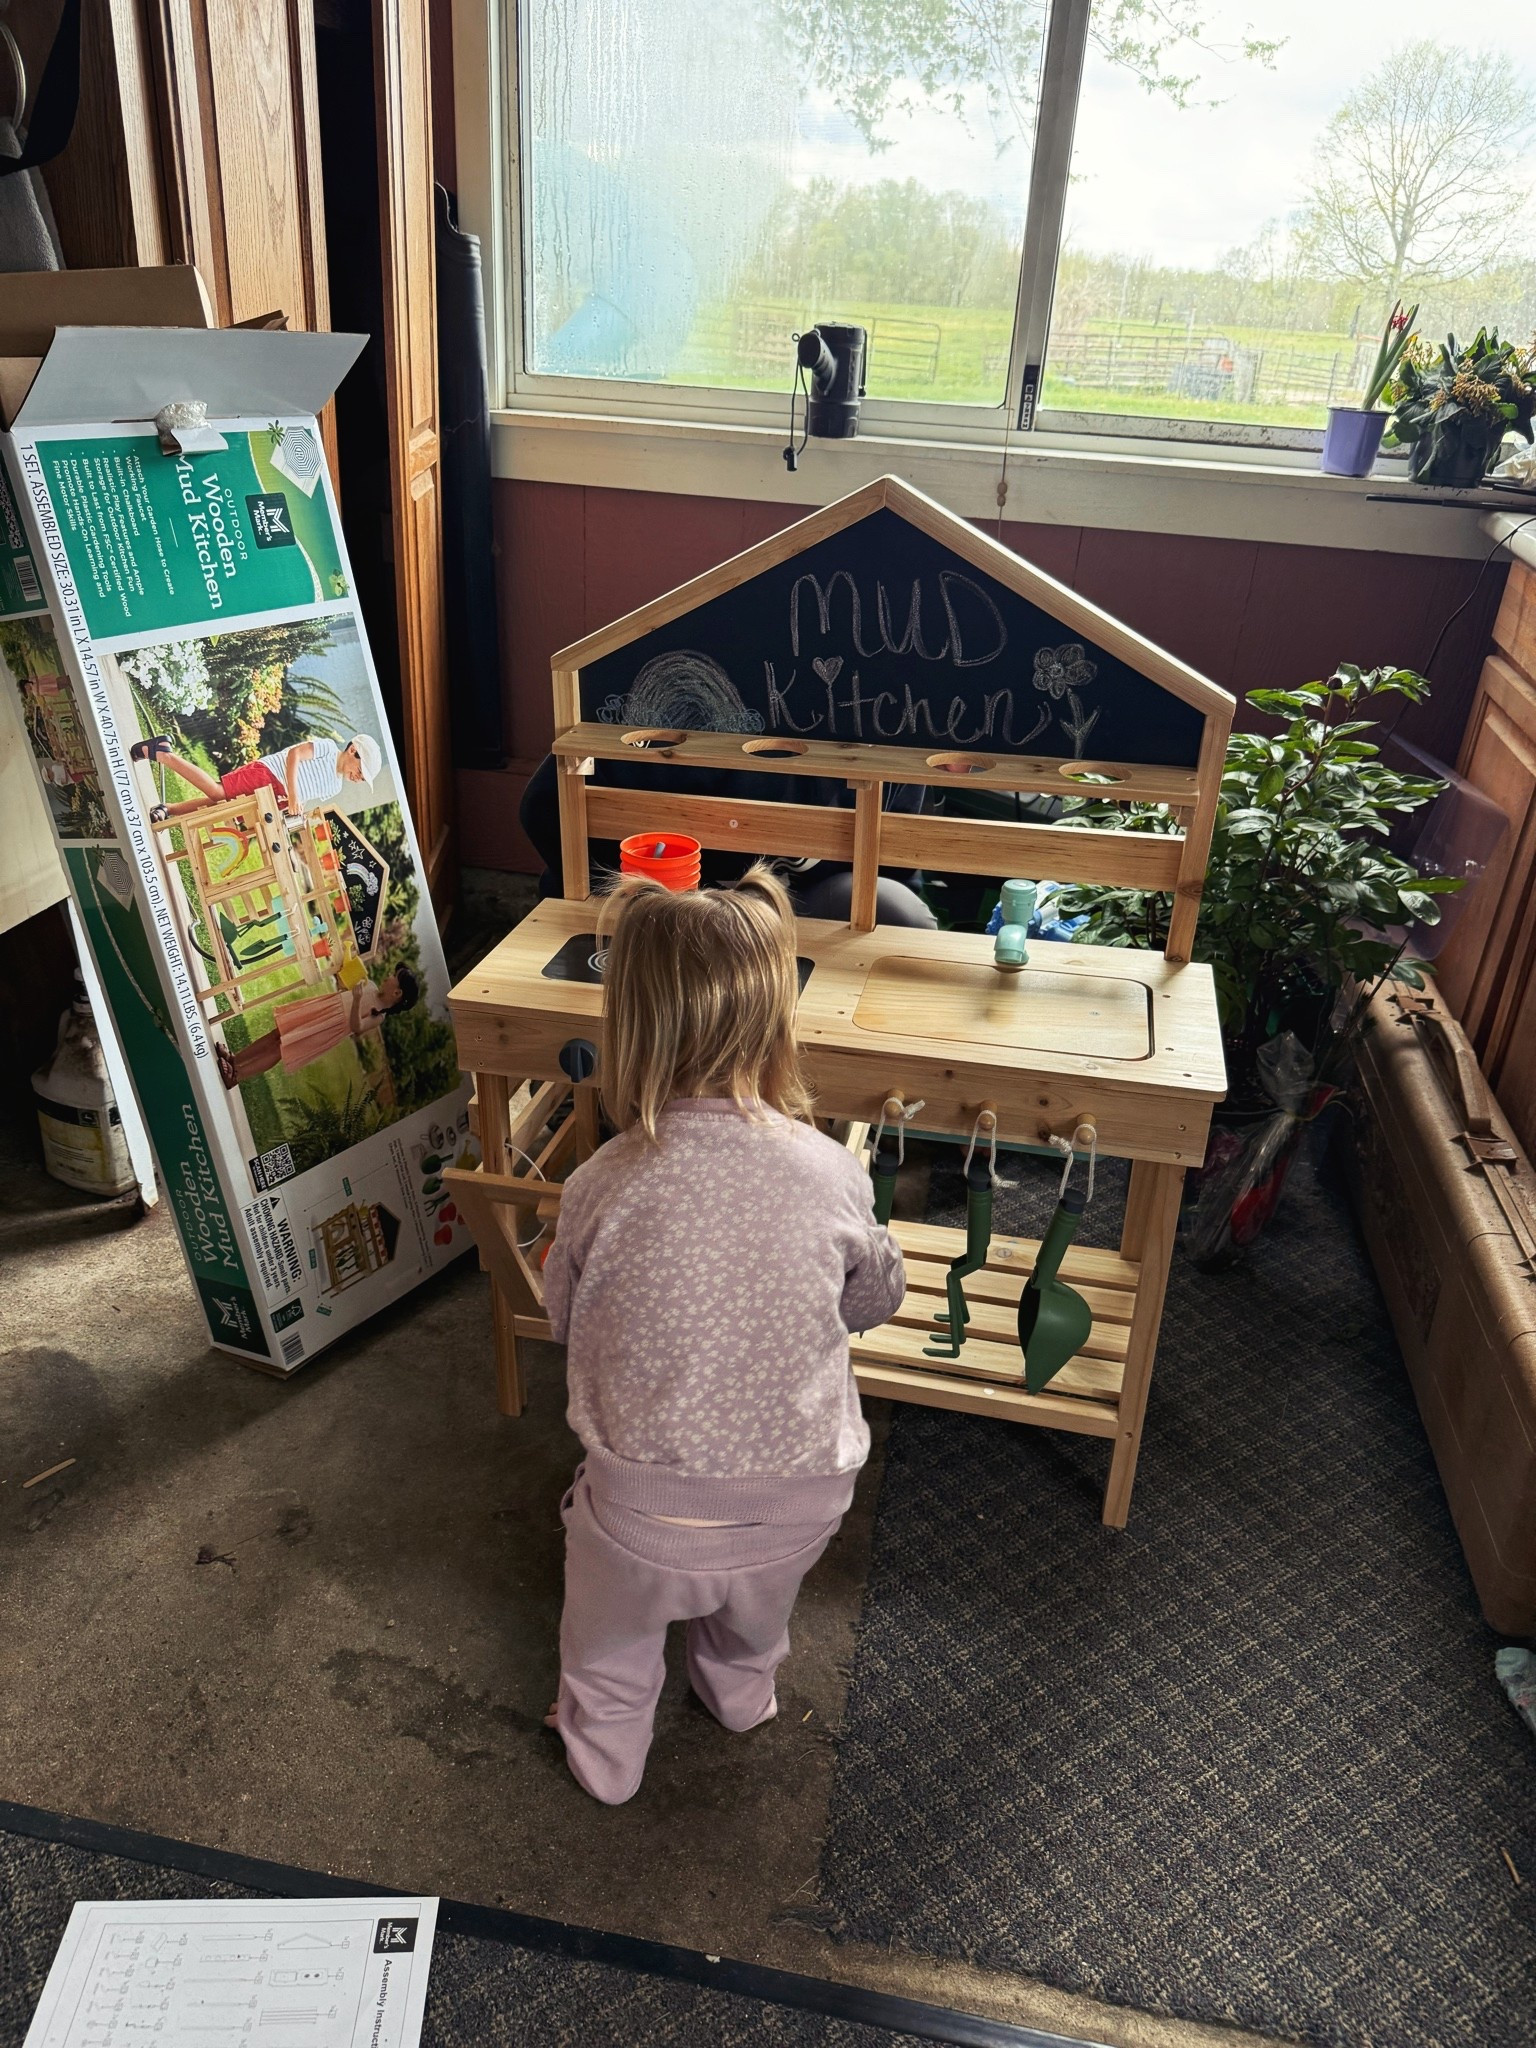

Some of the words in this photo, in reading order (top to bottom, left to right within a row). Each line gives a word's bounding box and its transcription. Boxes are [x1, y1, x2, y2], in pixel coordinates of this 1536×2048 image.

[22, 454, 40, 478] SET.
[102, 457, 116, 492] Realistic
[52, 460, 61, 479] Fine
[58, 481, 70, 506] Motor
[66, 508, 76, 531] Skills
[112, 494, 121, 512] Play
[113, 456, 126, 487] Built-in
[122, 488, 140, 536] Chalkboard
[125, 456, 138, 491] Working
[134, 493, 146, 521] Faucet
[30, 480, 61, 550] ASSEMBLED
[61, 460, 75, 496] Promote
[72, 499, 88, 541] Hands-On
[85, 543, 99, 580] Learning
[96, 582, 106, 597] and
[70, 459, 84, 493] Durable
[80, 495, 92, 523] Plastic
[89, 525, 105, 568] Gardening
[102, 570, 111, 591] Tools
[93, 457, 106, 490] Storage
[107, 506, 120, 541] Outdoor
[117, 543, 130, 574] Kitchen
[126, 576, 134, 591] Fun
[133, 455, 144, 483] Attach
[141, 484, 150, 503] Your
[146, 505, 158, 535] Garden
[154, 536, 164, 557] Hose
[160, 558, 166, 567] to
[163, 568, 174, 595] Create
[202, 472, 236, 578] Wooden
[224, 488, 248, 560] OUTDOOR
[257, 501, 272, 541] Member's
[82, 458, 92, 478] Built
[88, 480, 94, 490] to
[91, 491, 100, 509] Last
[97, 511, 106, 531] from
[109, 555, 124, 591] Certified
[120, 592, 132, 616] Wood
[118, 514, 131, 549] Features
[51, 552, 69, 579] SIZE:
[128, 551, 137, 567] and
[188, 512, 222, 609] Kitchen
[59, 581, 79, 612] 30.31
[132, 568, 144, 595] Ample
[69, 615, 82, 626] in
[75, 636, 89, 644] X
[79, 646, 98, 676] 14.57
[88, 678, 100, 690] in
[93, 690, 107, 703] W
[96, 705, 109, 713] X
[100, 715, 118, 745] 40.75
[108, 746, 120, 757] in
[111, 758, 125, 768] H
[113, 770, 130, 785] (77
[120, 789, 132, 805] cm
[125, 806, 135, 814] x
[127, 814, 141, 826] 37
[132, 830, 144, 846] cm
[136, 846, 146, 854] x
[140, 854, 157, 883] 103.5
[148, 885, 164, 908] cm).
[155, 908, 171, 927] NET
[162, 928, 183, 972] WEIGHT:
[174, 972, 191, 999] 14.11
[182, 999, 197, 1022] LBS.
[188, 1022, 202, 1042] (6.4
[192, 1041, 208, 1061] kg)
[182, 1104, 219, 1204] Kitchen
[175, 1189, 201, 1261] OUTDOOR
[180, 1161, 217, 1262] Wooden
[260, 1198, 274, 1231] CHOKING
[208, 1212, 238, 1269] Mud
[244, 1208, 255, 1226] Adult
[250, 1226, 264, 1259] assembly
[259, 1259, 273, 1290] required.
[252, 1202, 260, 1215] Not
[258, 1224, 269, 1249] children
[265, 1249, 274, 1266] under
[270, 1270, 280, 1289] years.
[277, 1218, 302, 1282] WARNING:
[376, 1959, 392, 2007] Assembly
